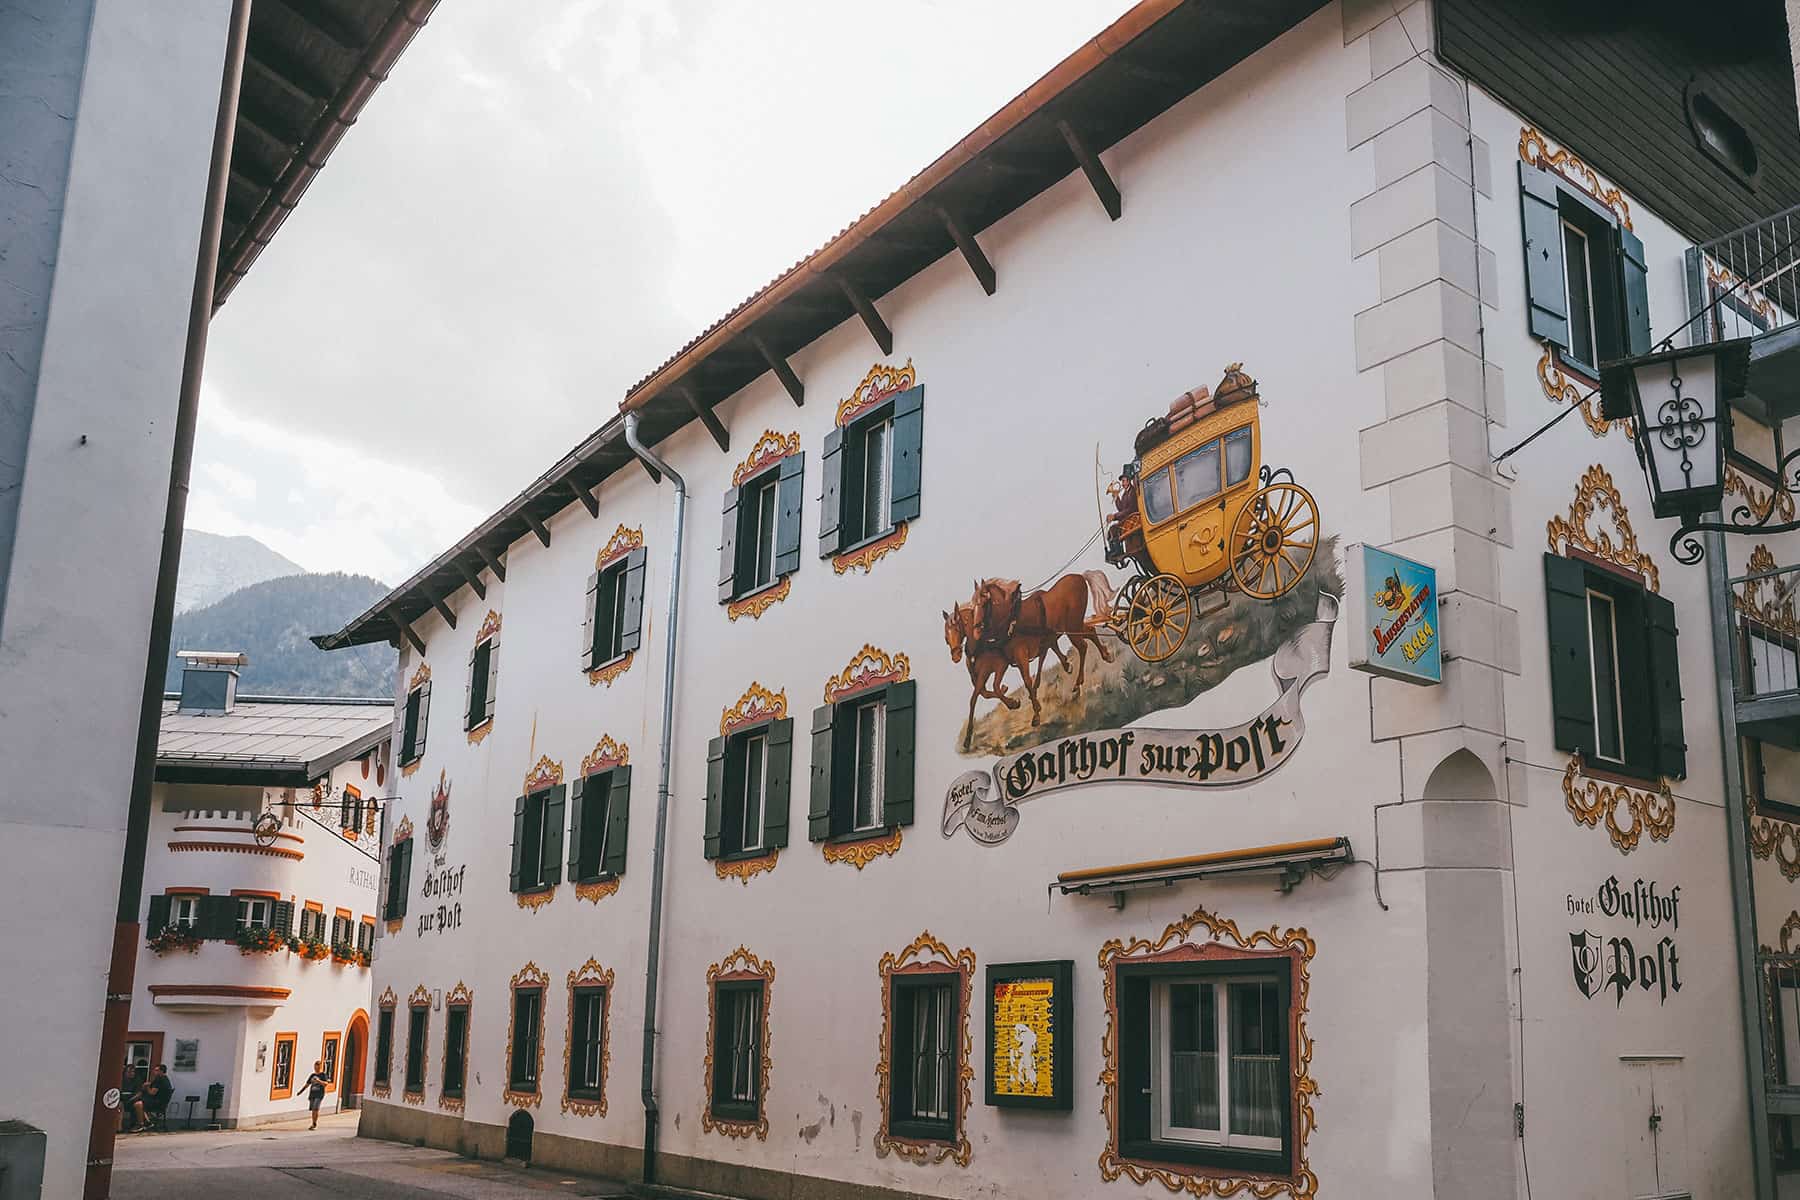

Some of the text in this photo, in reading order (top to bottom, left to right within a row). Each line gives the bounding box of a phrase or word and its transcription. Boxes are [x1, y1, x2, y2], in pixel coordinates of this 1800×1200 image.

[1005, 713, 1292, 798] Gasthof zur Post
[950, 778, 978, 806] Hotel
[423, 864, 466, 899] Gasthof
[1566, 875, 1682, 932] Hotel Gasthof
[418, 902, 463, 938] zur Post
[1604, 936, 1683, 1010] Post
